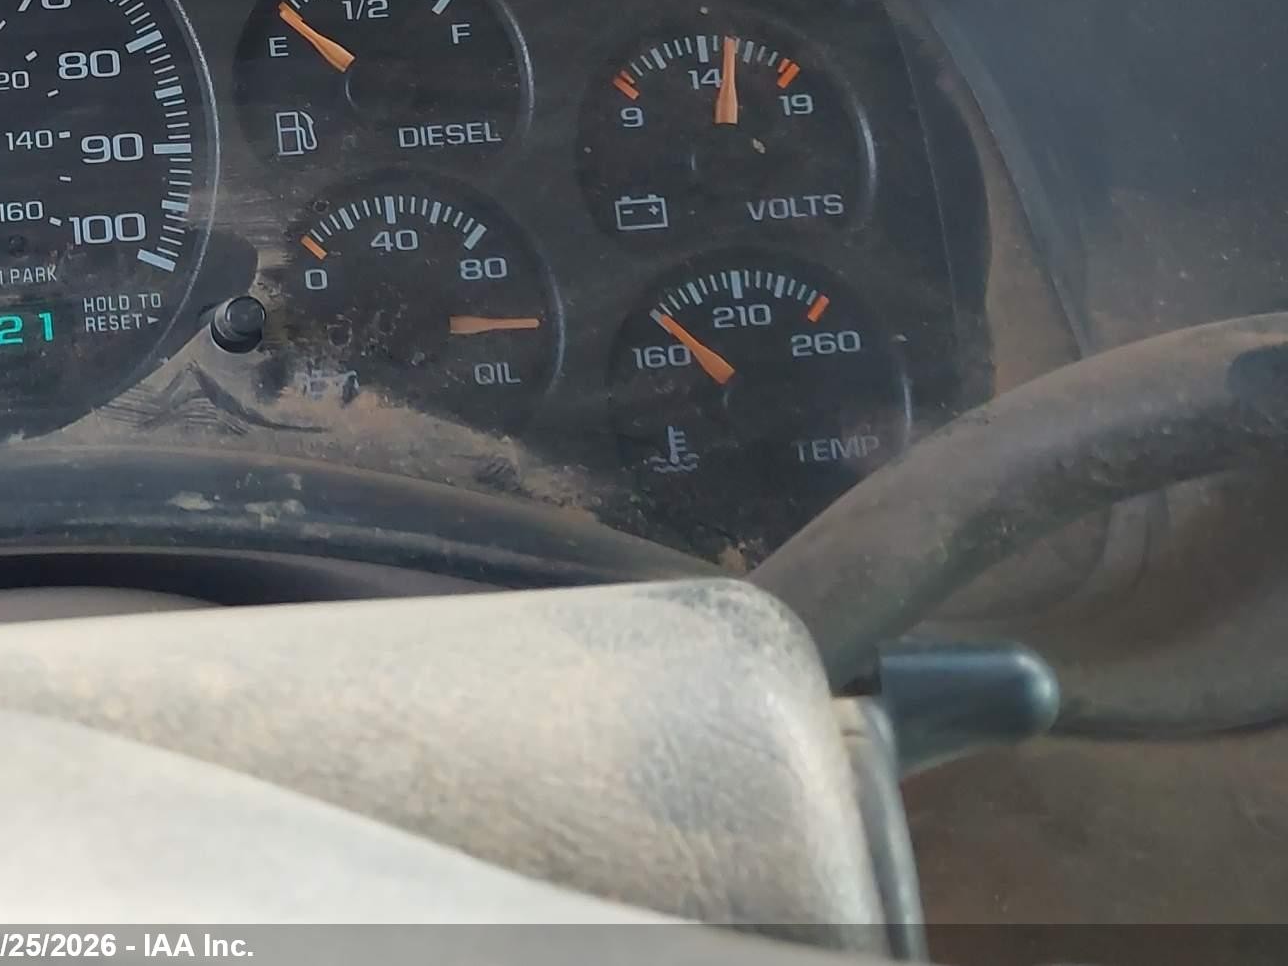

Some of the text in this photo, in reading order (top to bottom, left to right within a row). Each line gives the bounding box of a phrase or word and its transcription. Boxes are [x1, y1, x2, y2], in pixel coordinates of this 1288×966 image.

[451, 23, 471, 45] F
[269, 36, 289, 58] E
[58, 50, 121, 80] 80
[688, 68, 722, 90] 14
[779, 94, 814, 116] 19
[620, 107, 644, 129] 9
[5, 129, 54, 151] 140
[397, 121, 501, 148] DIESEL
[81, 134, 144, 164] 90
[746, 194, 844, 221] VOLTS
[69, 214, 146, 245] 100
[370, 229, 419, 252] 40
[10, 265, 57, 284] PARK
[305, 269, 328, 290] 0
[459, 256, 508, 280] 80
[83, 292, 162, 313] HOLD TO
[38, 311, 54, 342] 1
[84, 314, 143, 333] RESET
[712, 304, 772, 329] 210
[791, 331, 861, 357] 260
[631, 345, 691, 370] 160
[795, 434, 881, 463] TEMP
